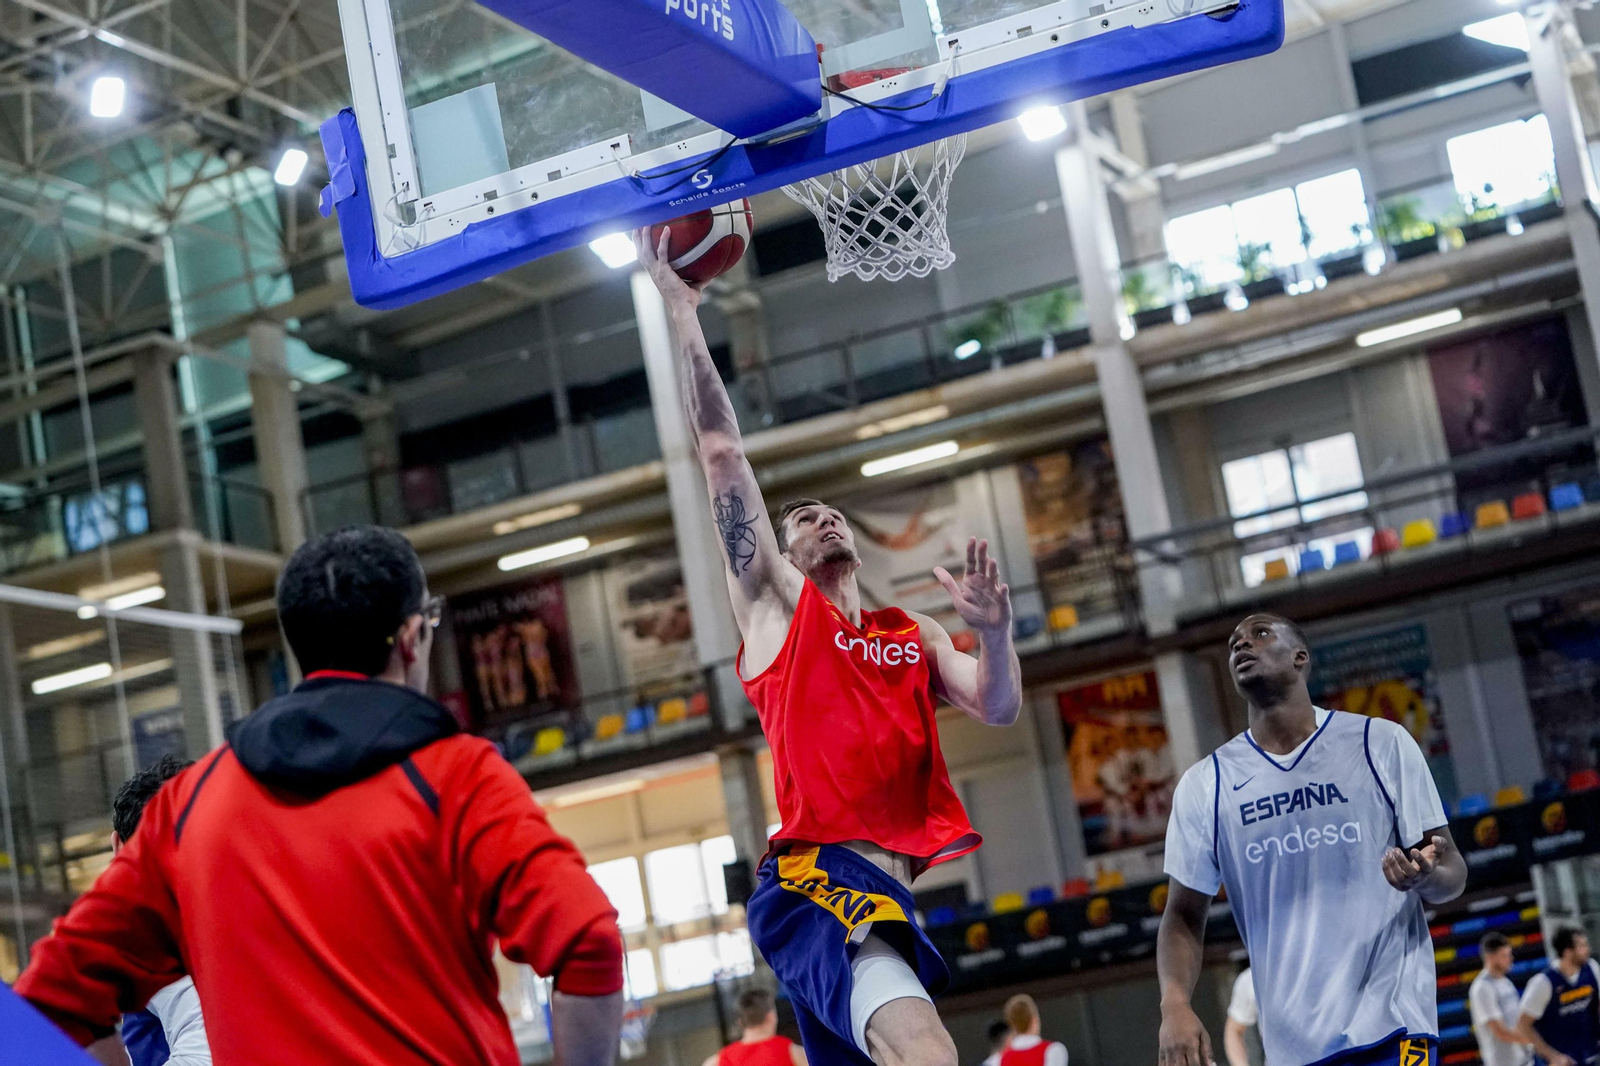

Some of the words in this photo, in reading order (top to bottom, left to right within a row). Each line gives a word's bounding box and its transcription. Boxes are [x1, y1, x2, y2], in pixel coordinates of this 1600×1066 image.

[711, 181, 746, 194] Sports
[1239, 782, 1349, 826] ESPAÑA
[1245, 821, 1361, 864] endesa
